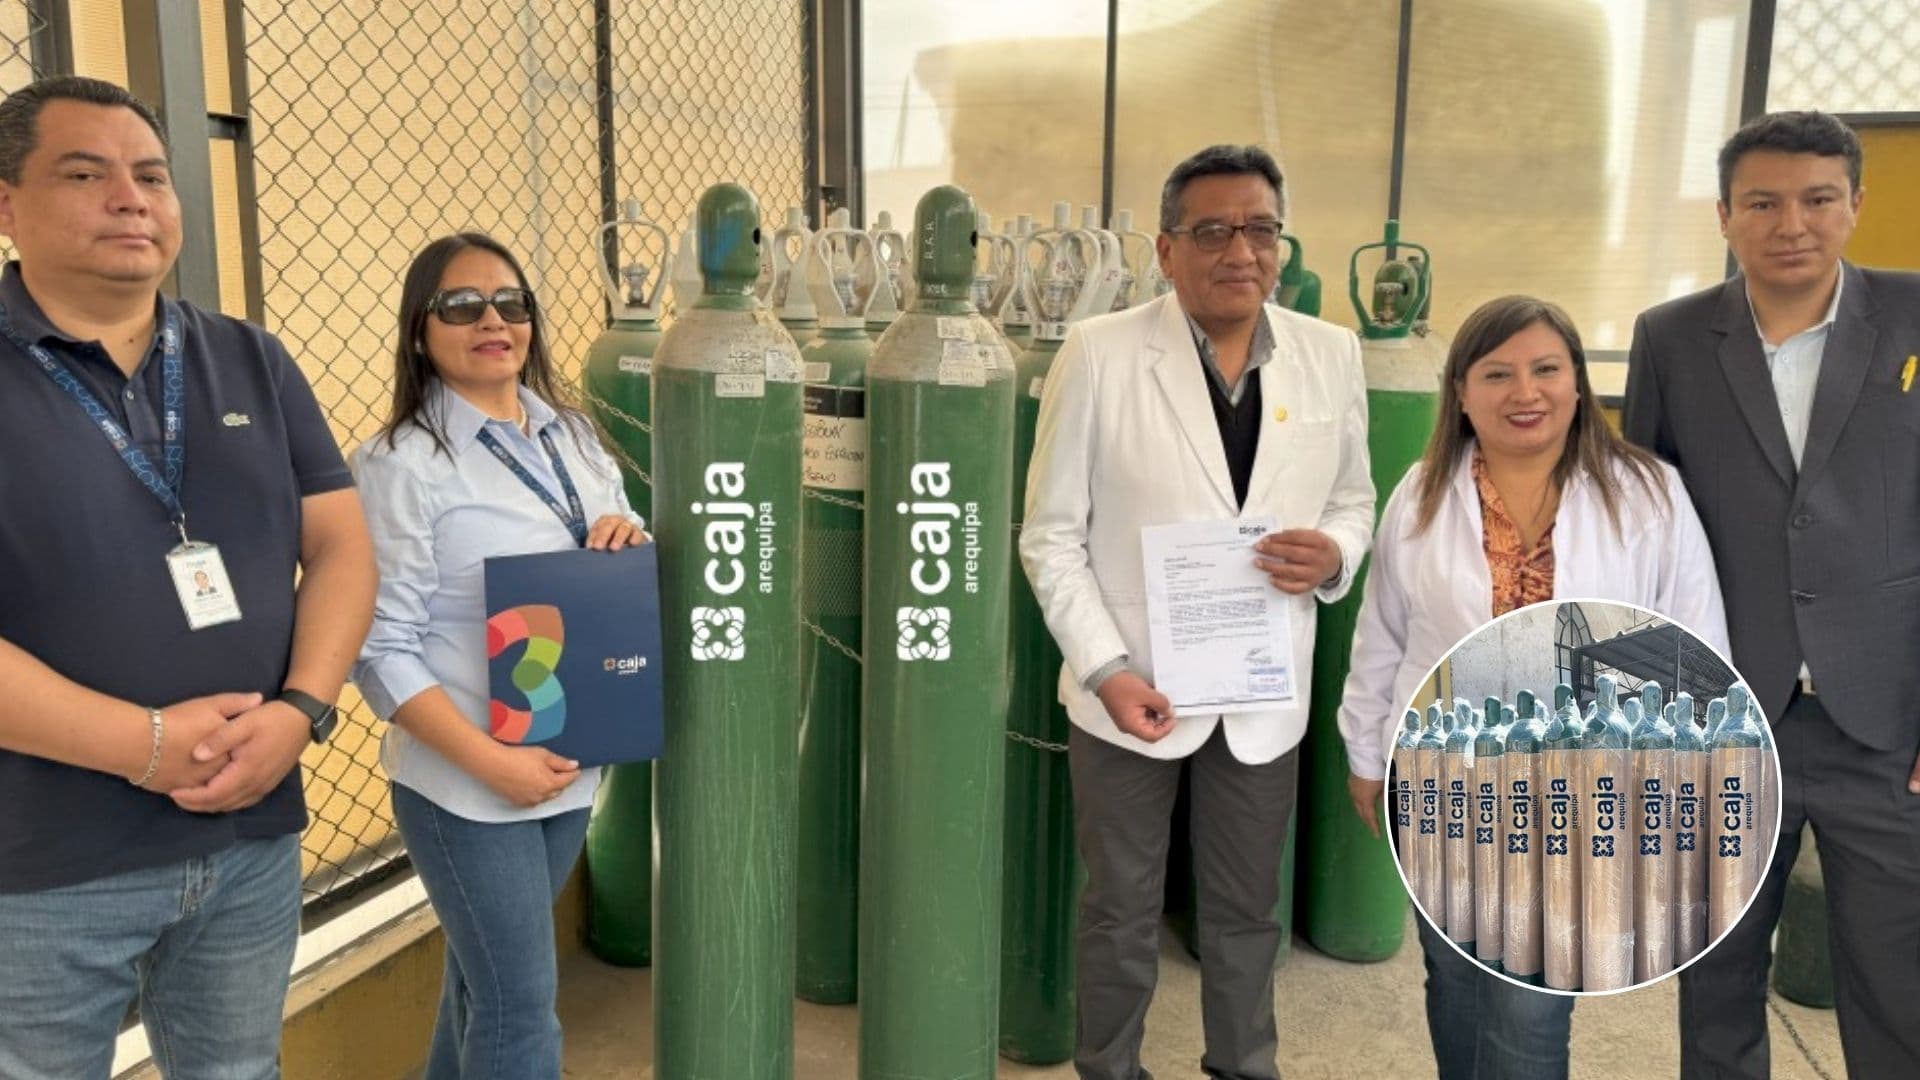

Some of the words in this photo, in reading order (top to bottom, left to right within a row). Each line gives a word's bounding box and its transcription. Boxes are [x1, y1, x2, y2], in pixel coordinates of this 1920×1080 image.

[691, 462, 755, 595] caja
[755, 502, 776, 594] arequipa
[896, 462, 961, 595] caja
[961, 502, 982, 594] arequipa
[617, 654, 647, 671] caja
[1398, 781, 1412, 812] caja
[1420, 779, 1438, 816] caja
[1447, 780, 1466, 819] caja
[1476, 783, 1495, 823] caja
[1508, 780, 1531, 829] caja
[1546, 779, 1570, 830] caja
[1570, 794, 1579, 829] arequipa
[1592, 777, 1617, 830] caja
[1618, 792, 1627, 830] arequipa
[1640, 779, 1664, 830] caja
[1664, 793, 1672, 829] arequipa
[1676, 783, 1698, 828] caja
[1719, 777, 1744, 830] caja
[1745, 792, 1754, 830] arequipa
